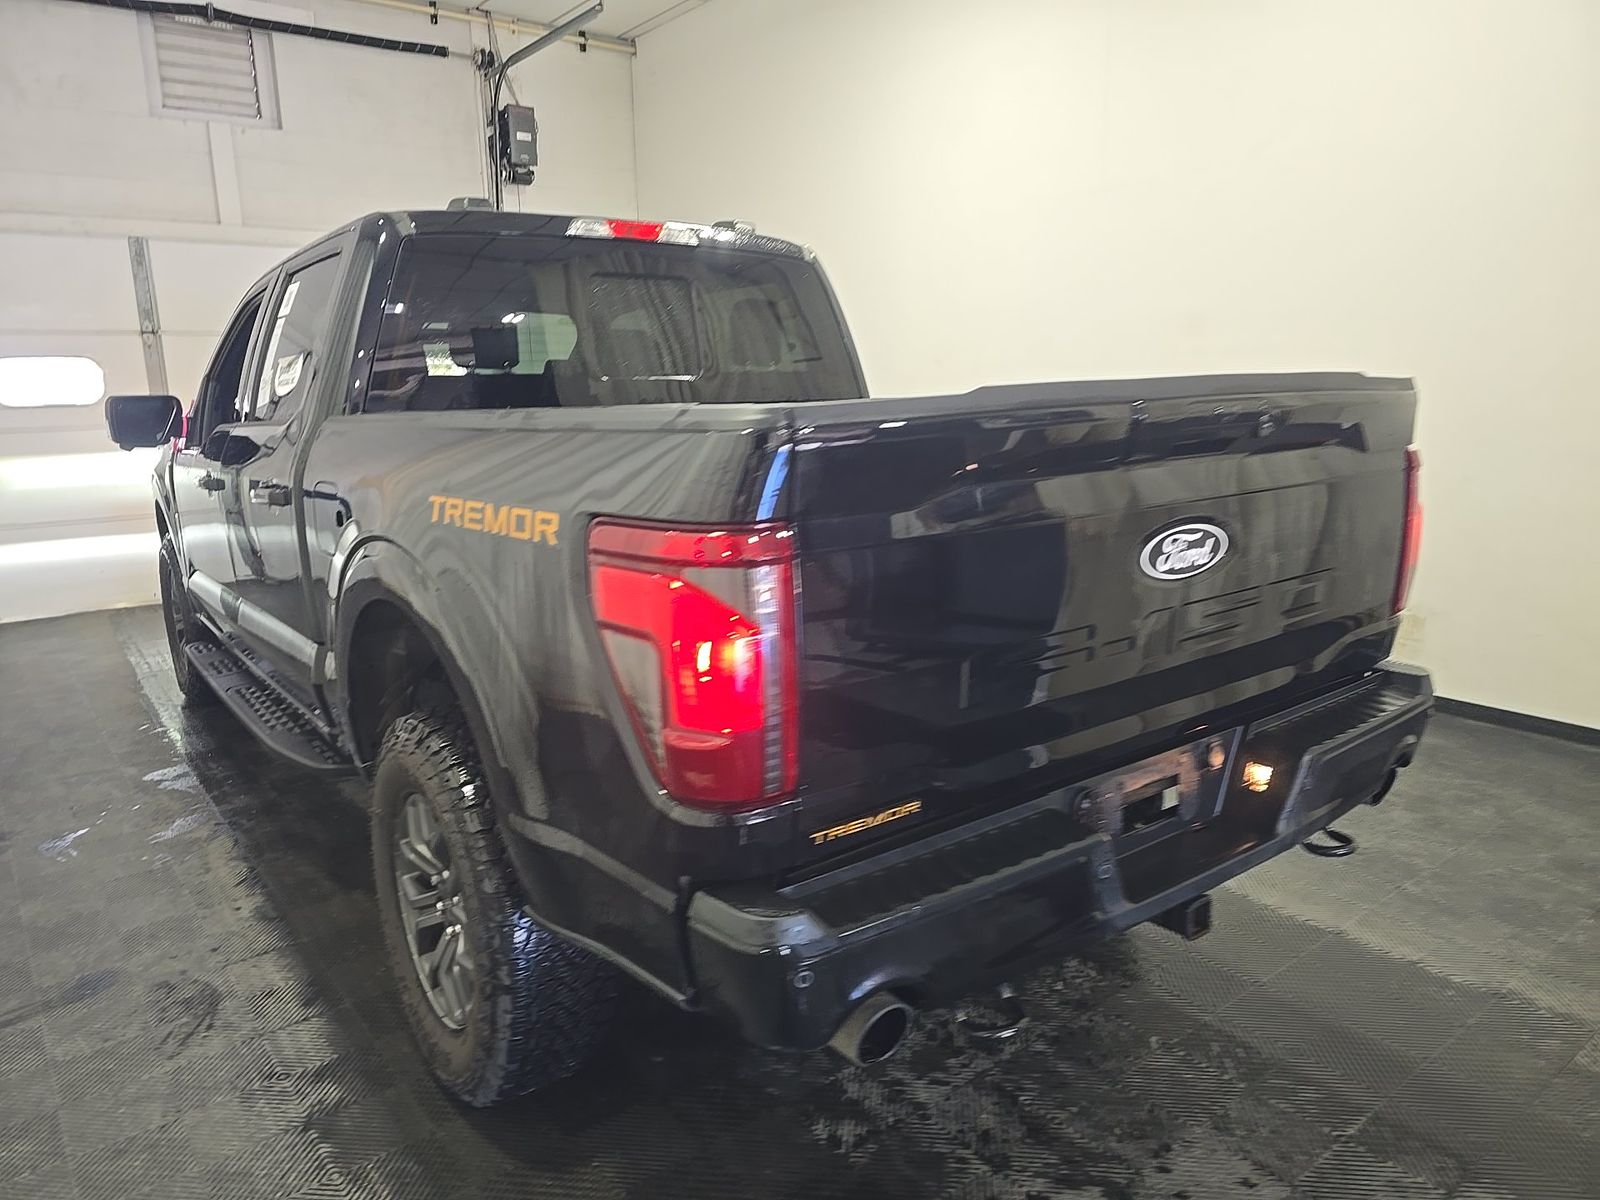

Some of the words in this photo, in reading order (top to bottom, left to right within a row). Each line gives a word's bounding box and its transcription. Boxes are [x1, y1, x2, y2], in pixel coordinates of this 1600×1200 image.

[428, 495, 561, 546] TREMOR
[1154, 530, 1217, 573] Ford
[808, 800, 922, 845] TREMOR
